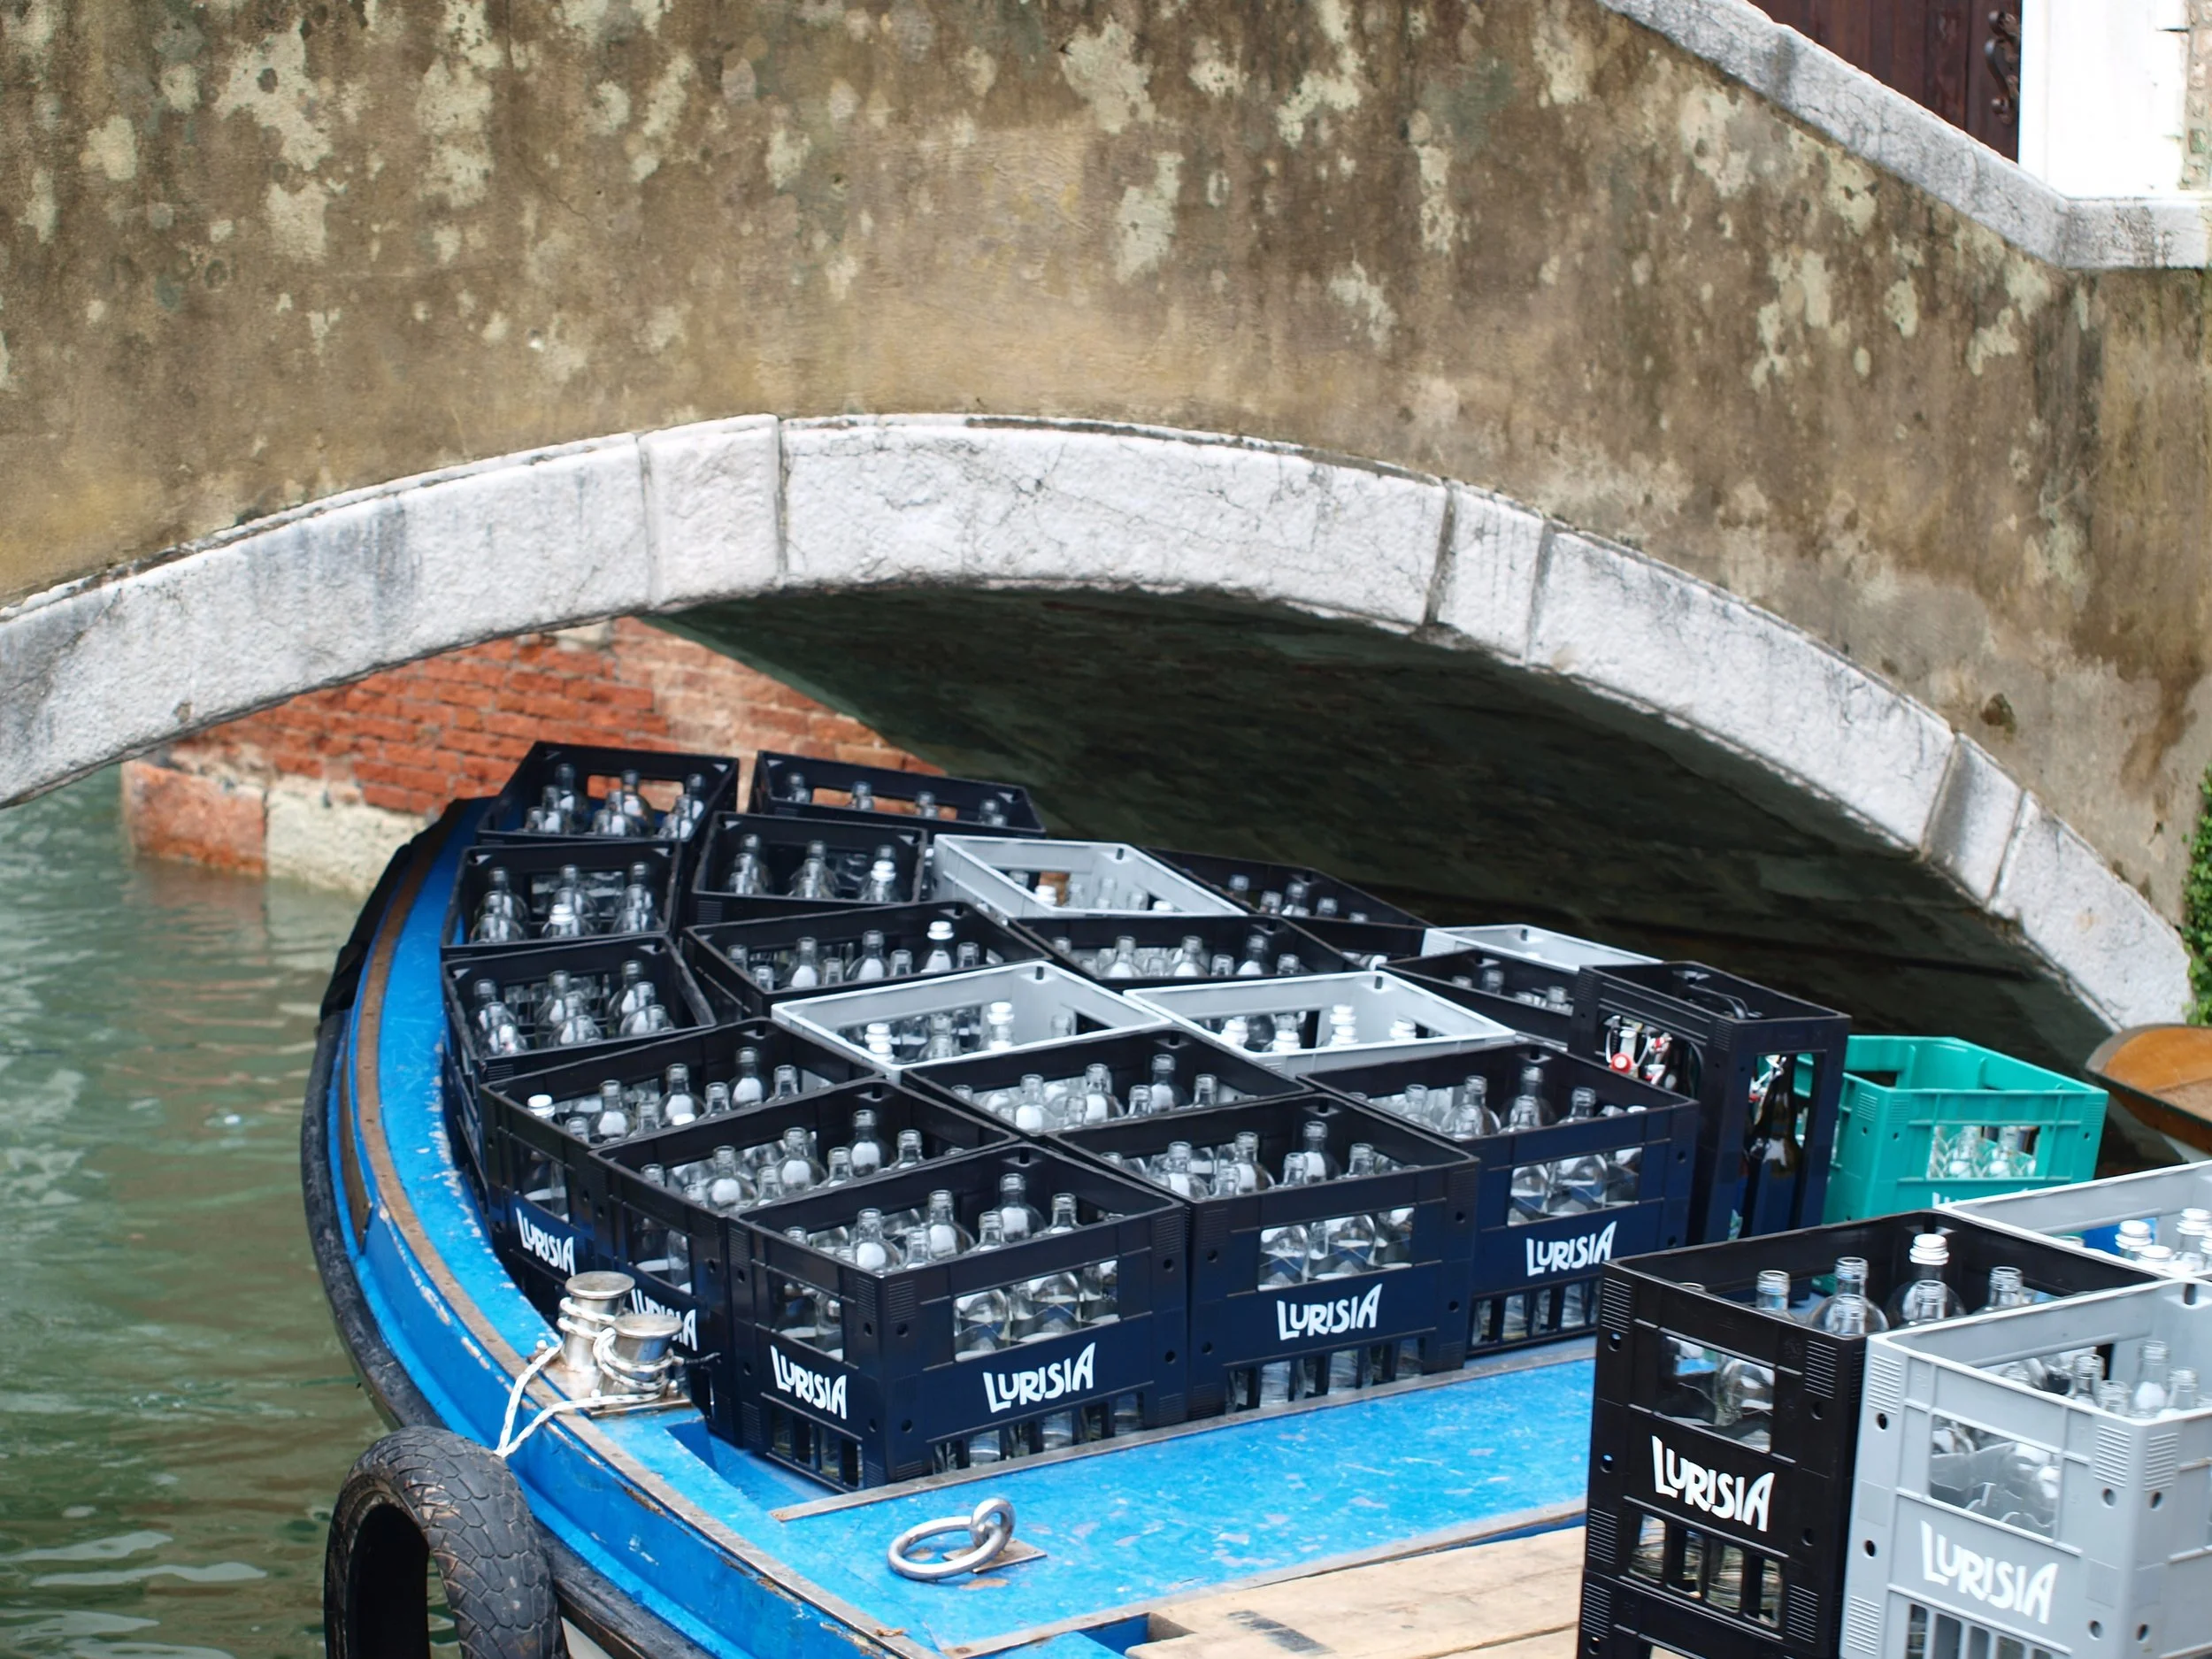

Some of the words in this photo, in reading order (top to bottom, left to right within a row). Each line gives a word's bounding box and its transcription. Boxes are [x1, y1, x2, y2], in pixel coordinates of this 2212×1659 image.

[516, 1207, 576, 1276] LURISIA
[1525, 1221, 1617, 1277] LURISIA
[631, 1288, 698, 1352] URIA
[1277, 1283, 1383, 1340] LURISIA
[770, 1345, 847, 1420] LURISIA
[982, 1342, 1095, 1413] LURISIA
[1651, 1435, 1775, 1532] LURISIA
[1920, 1520, 2059, 1624] LURISIA
